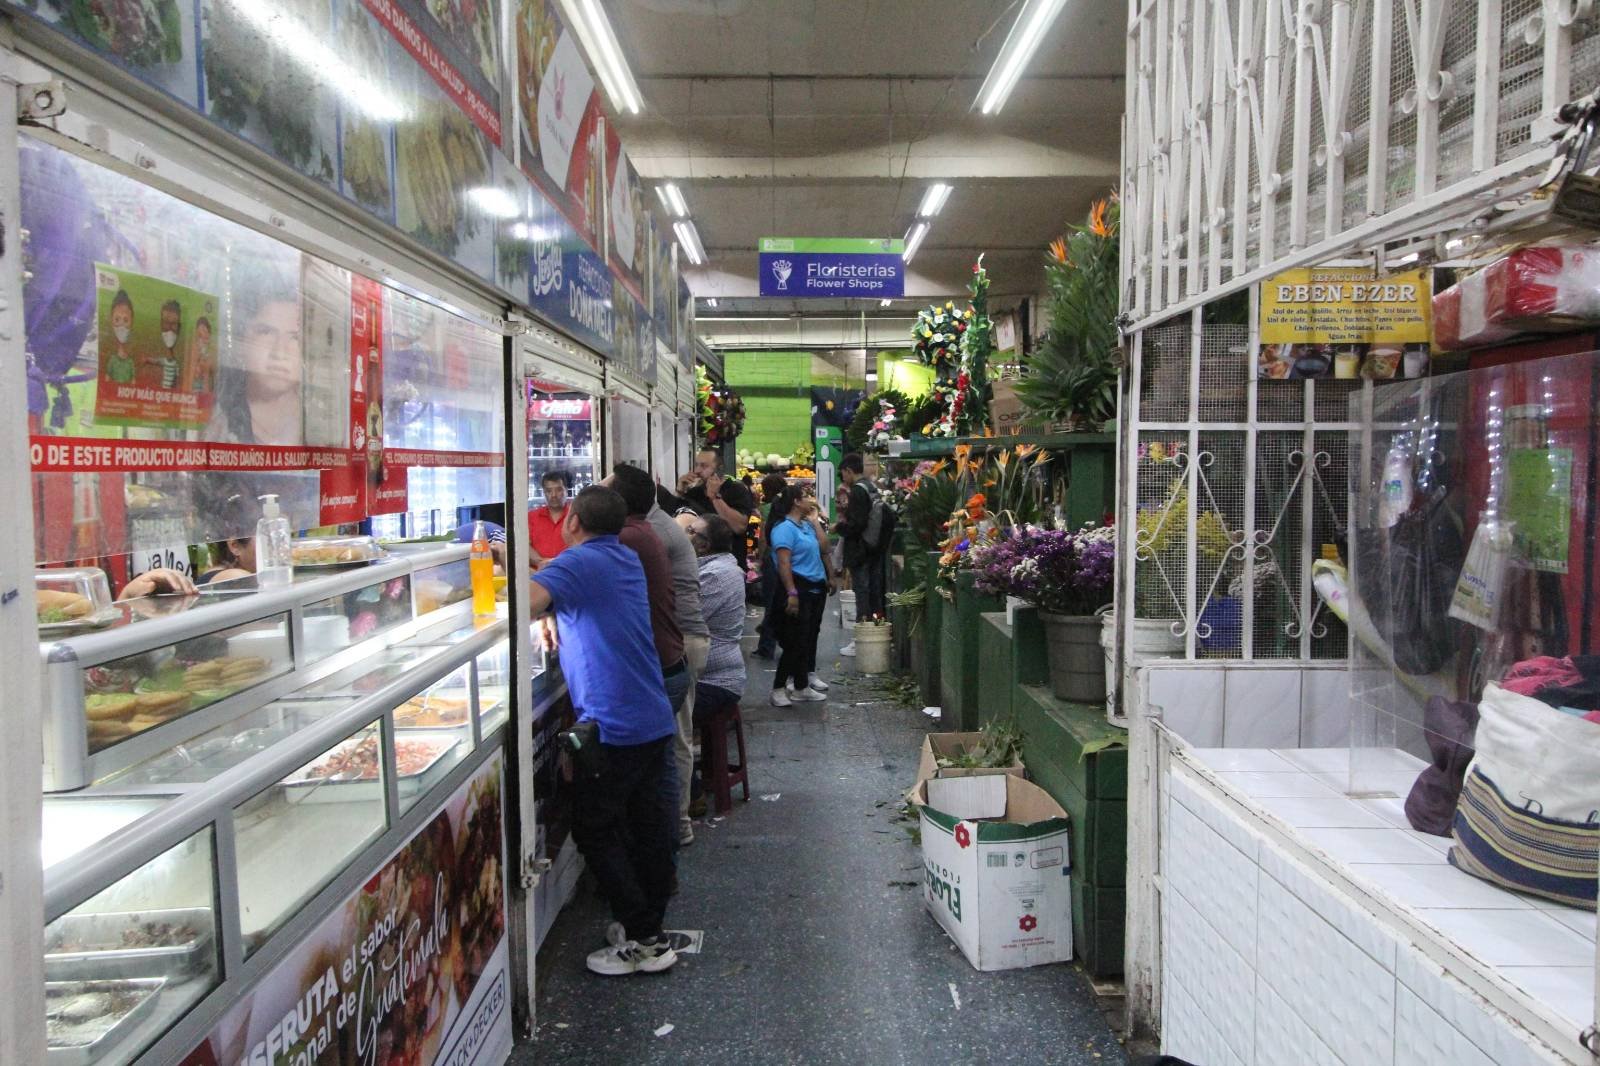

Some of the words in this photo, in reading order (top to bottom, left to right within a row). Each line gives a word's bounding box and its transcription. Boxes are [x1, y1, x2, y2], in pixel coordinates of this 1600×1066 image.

[807, 263, 896, 277] Floristerías
[806, 278, 845, 288] Flower
[848, 278, 883, 290] Shops
[1276, 284, 1417, 303] EBEN-EZER
[569, 280, 594, 329] DOÑA
[117, 386, 137, 398] HOY
[137, 387, 155, 400] MÁS
[155, 390, 172, 403] QUE
[48, 445, 69, 465] DE
[74, 446, 111, 466] ESTE
[115, 447, 174, 466] PRODUCTO
[176, 448, 207, 466] CAUSA
[209, 449, 239, 466] SERIOS
[240, 448, 264, 467] DAÑOS
[265, 451, 272, 467] A
[273, 451, 283, 467] LA
[343, 944, 357, 983] el
[360, 907, 397, 964] sabor
[336, 992, 356, 1029] de
[357, 871, 449, 1066] Guatemala
[453, 983, 503, 1066] CK+DECKER
